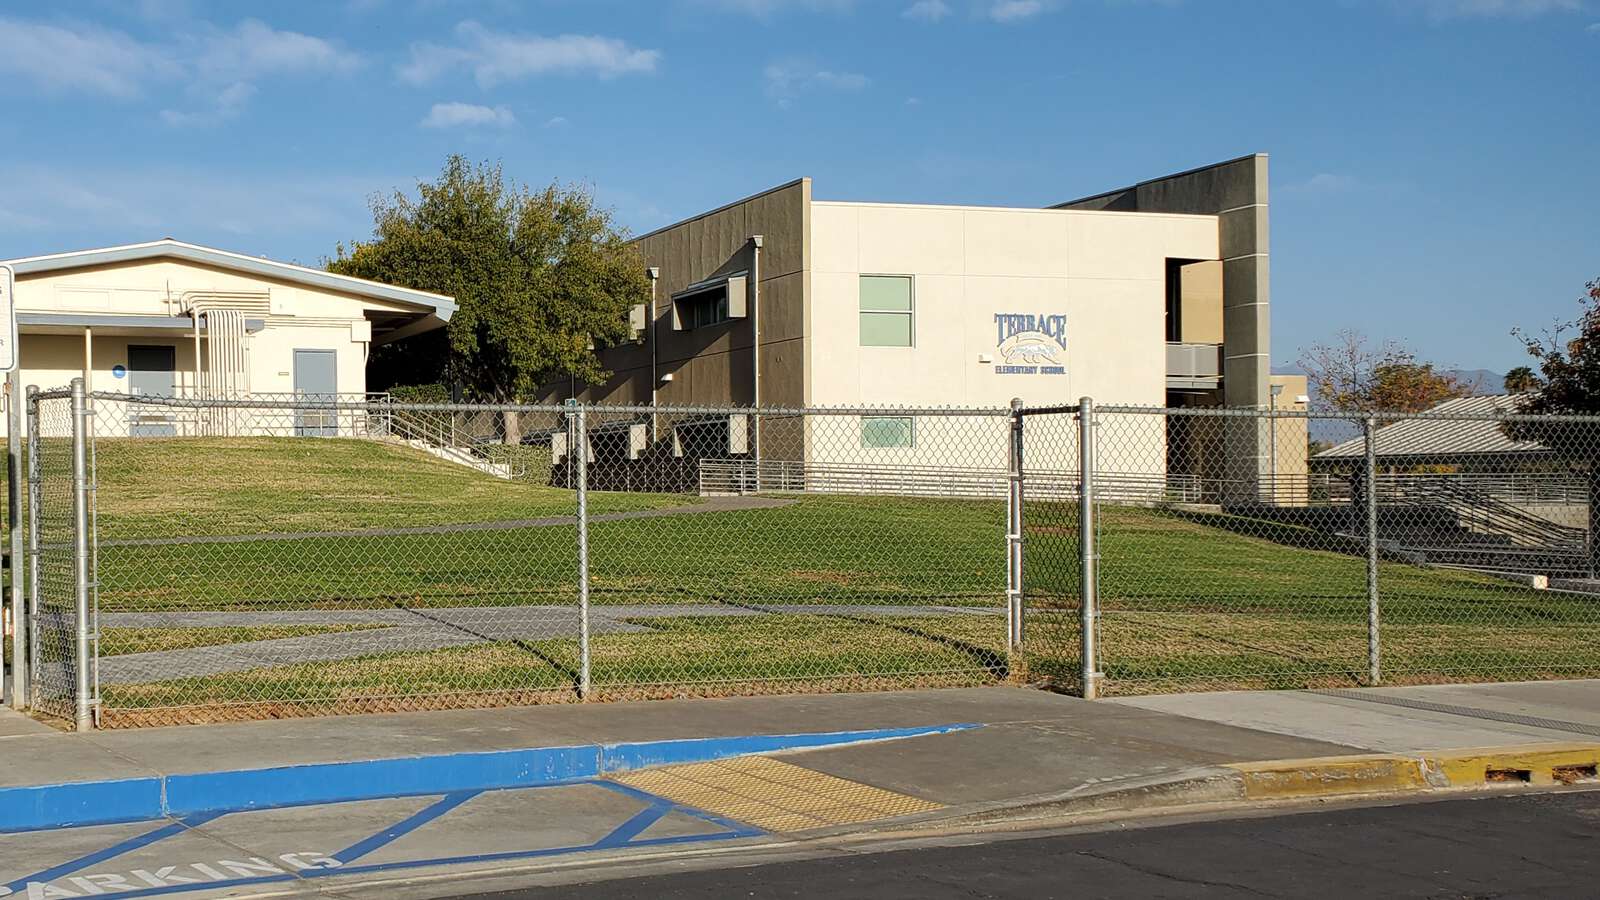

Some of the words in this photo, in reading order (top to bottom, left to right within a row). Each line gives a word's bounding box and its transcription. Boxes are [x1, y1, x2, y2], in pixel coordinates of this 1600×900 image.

[994, 313, 1066, 351] TERRACE
[995, 366, 1037, 374] ELEMENTARY
[1040, 366, 1066, 374] SCHOOL
[0, 852, 343, 900] ARKING
